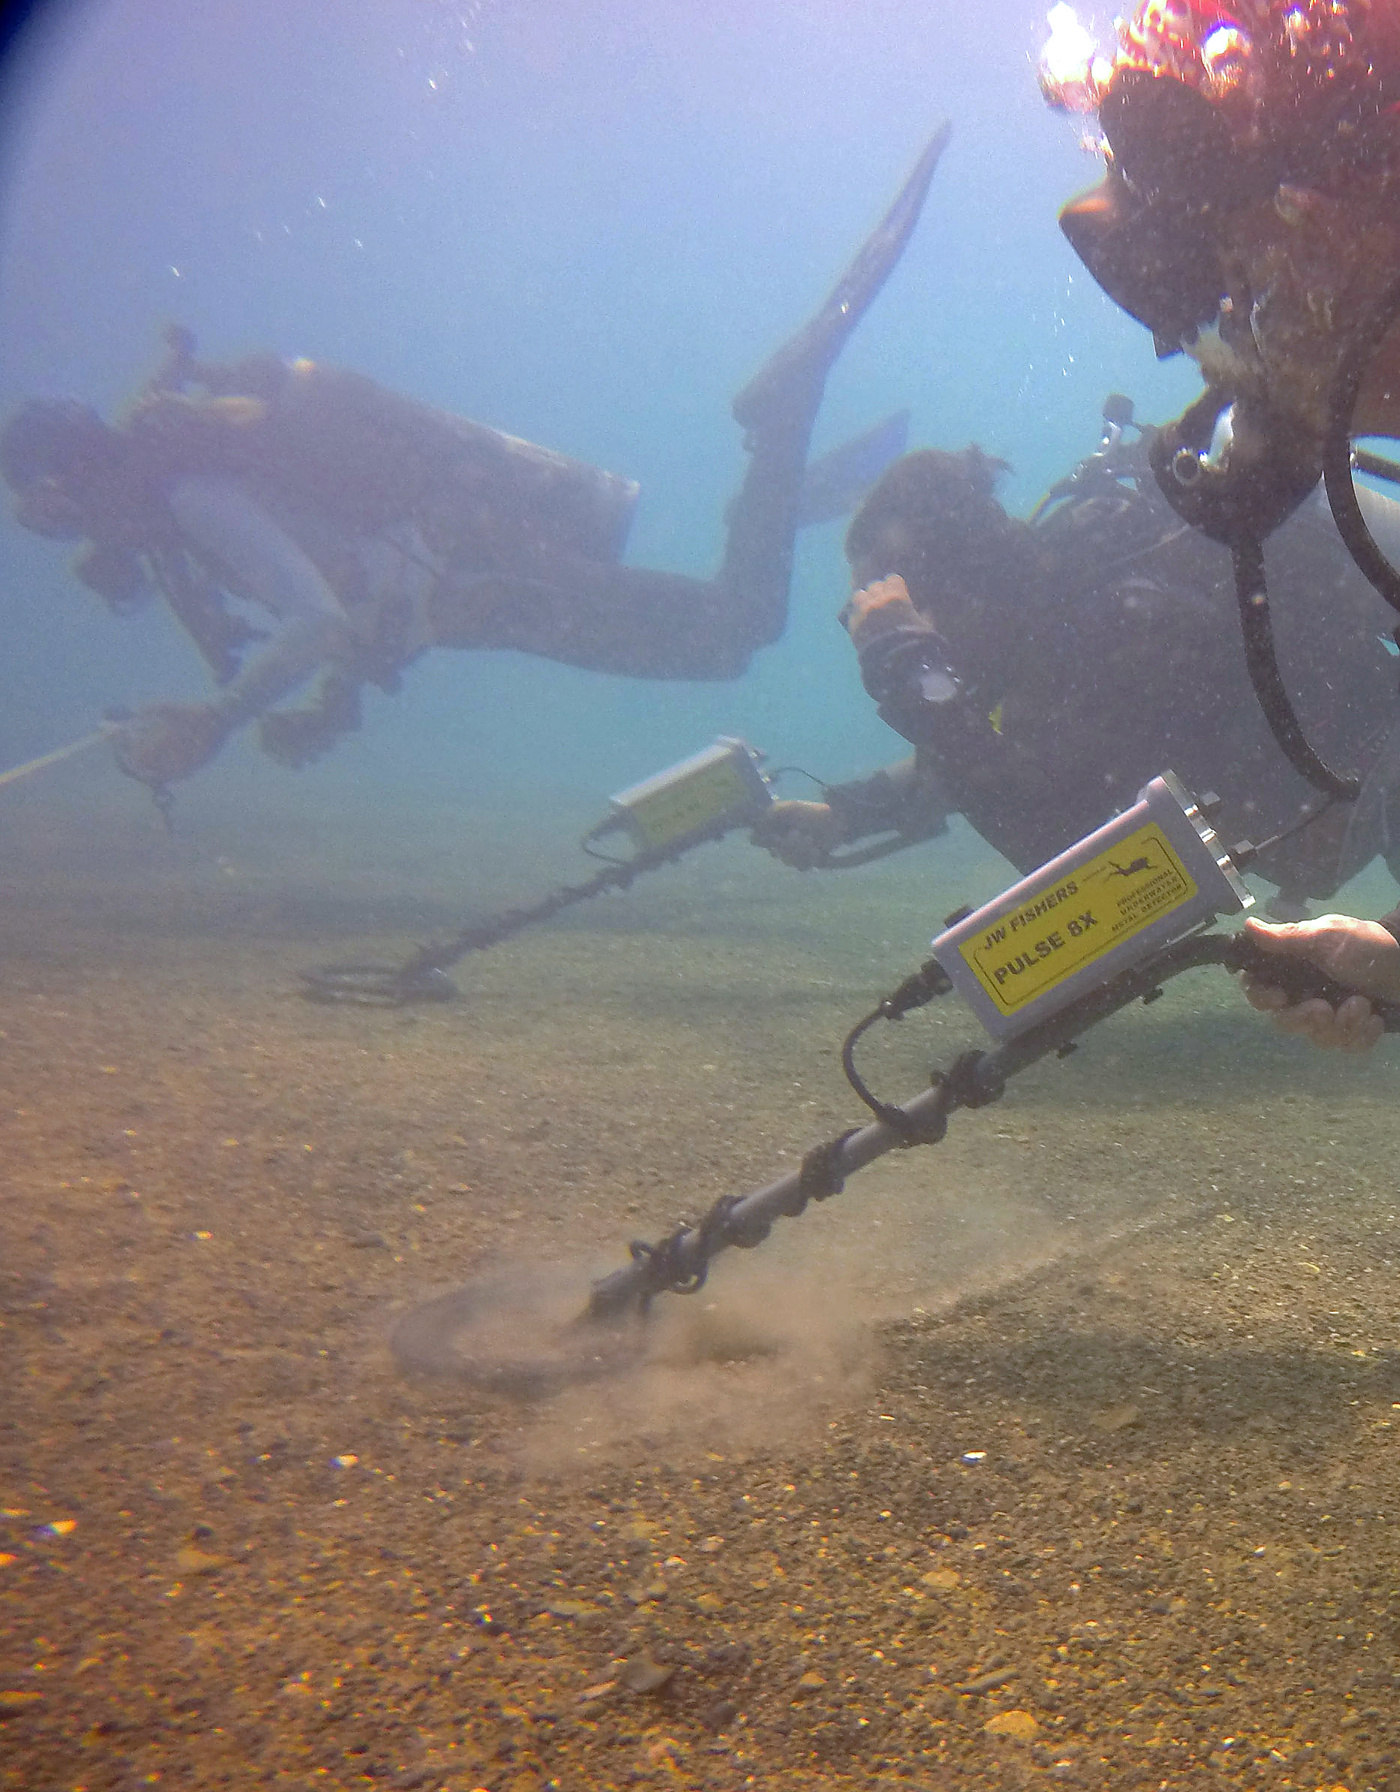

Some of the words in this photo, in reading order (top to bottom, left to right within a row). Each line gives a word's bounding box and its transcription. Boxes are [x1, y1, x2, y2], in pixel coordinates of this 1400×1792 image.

[984, 927, 1006, 950] JW
[1009, 881, 1079, 932] FISHERS
[994, 931, 1066, 985] PULSE
[1067, 910, 1098, 937] 8X
